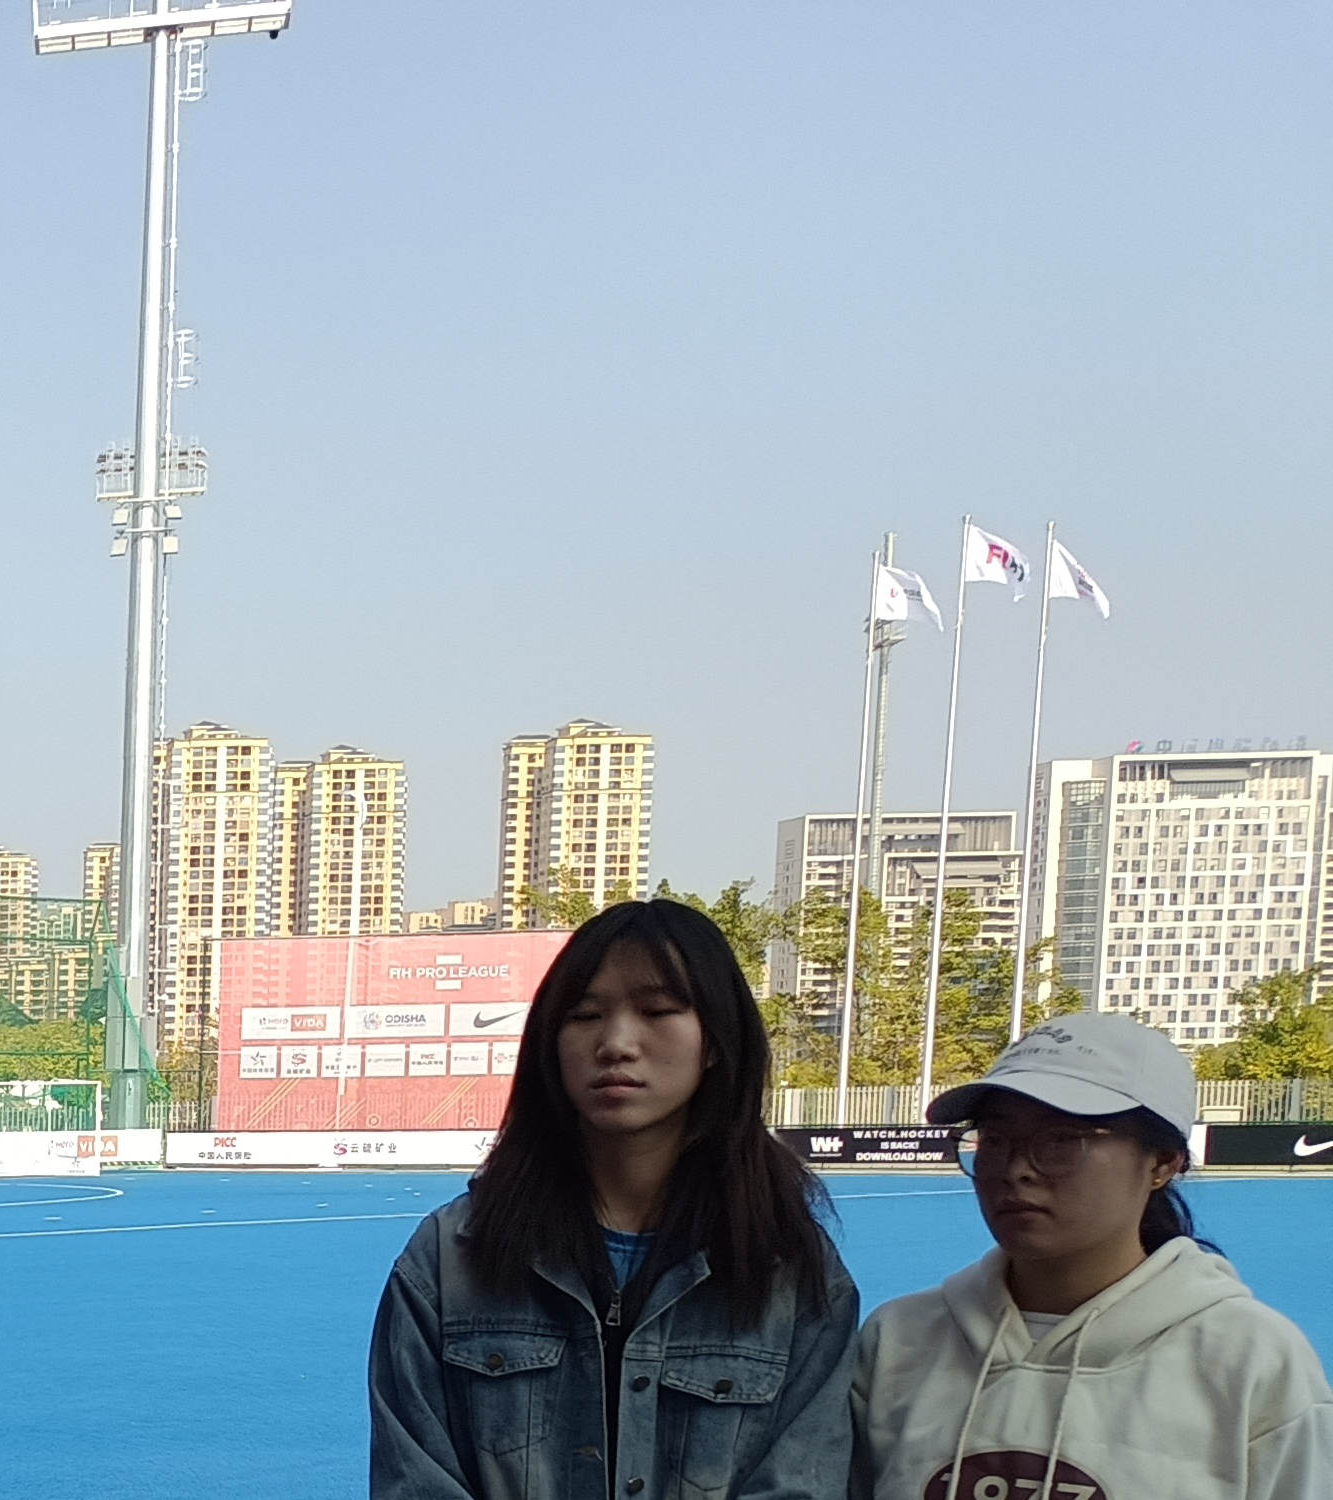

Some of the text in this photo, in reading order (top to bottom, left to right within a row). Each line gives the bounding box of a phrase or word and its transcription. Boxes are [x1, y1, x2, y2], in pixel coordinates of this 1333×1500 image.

[416, 966, 447, 979] PRO
[449, 965, 509, 978] LEAGUE
[294, 1018, 325, 1028] VIDA
[385, 1014, 426, 1023] ODISHA
[852, 1129, 950, 1139] WATCH.HOCKEY
[213, 1137, 237, 1147] PICC
[890, 1141, 920, 1150] BACK!
[79, 1142, 117, 1153] VIA
[855, 1152, 944, 1161] DOWNLOAD NOW
